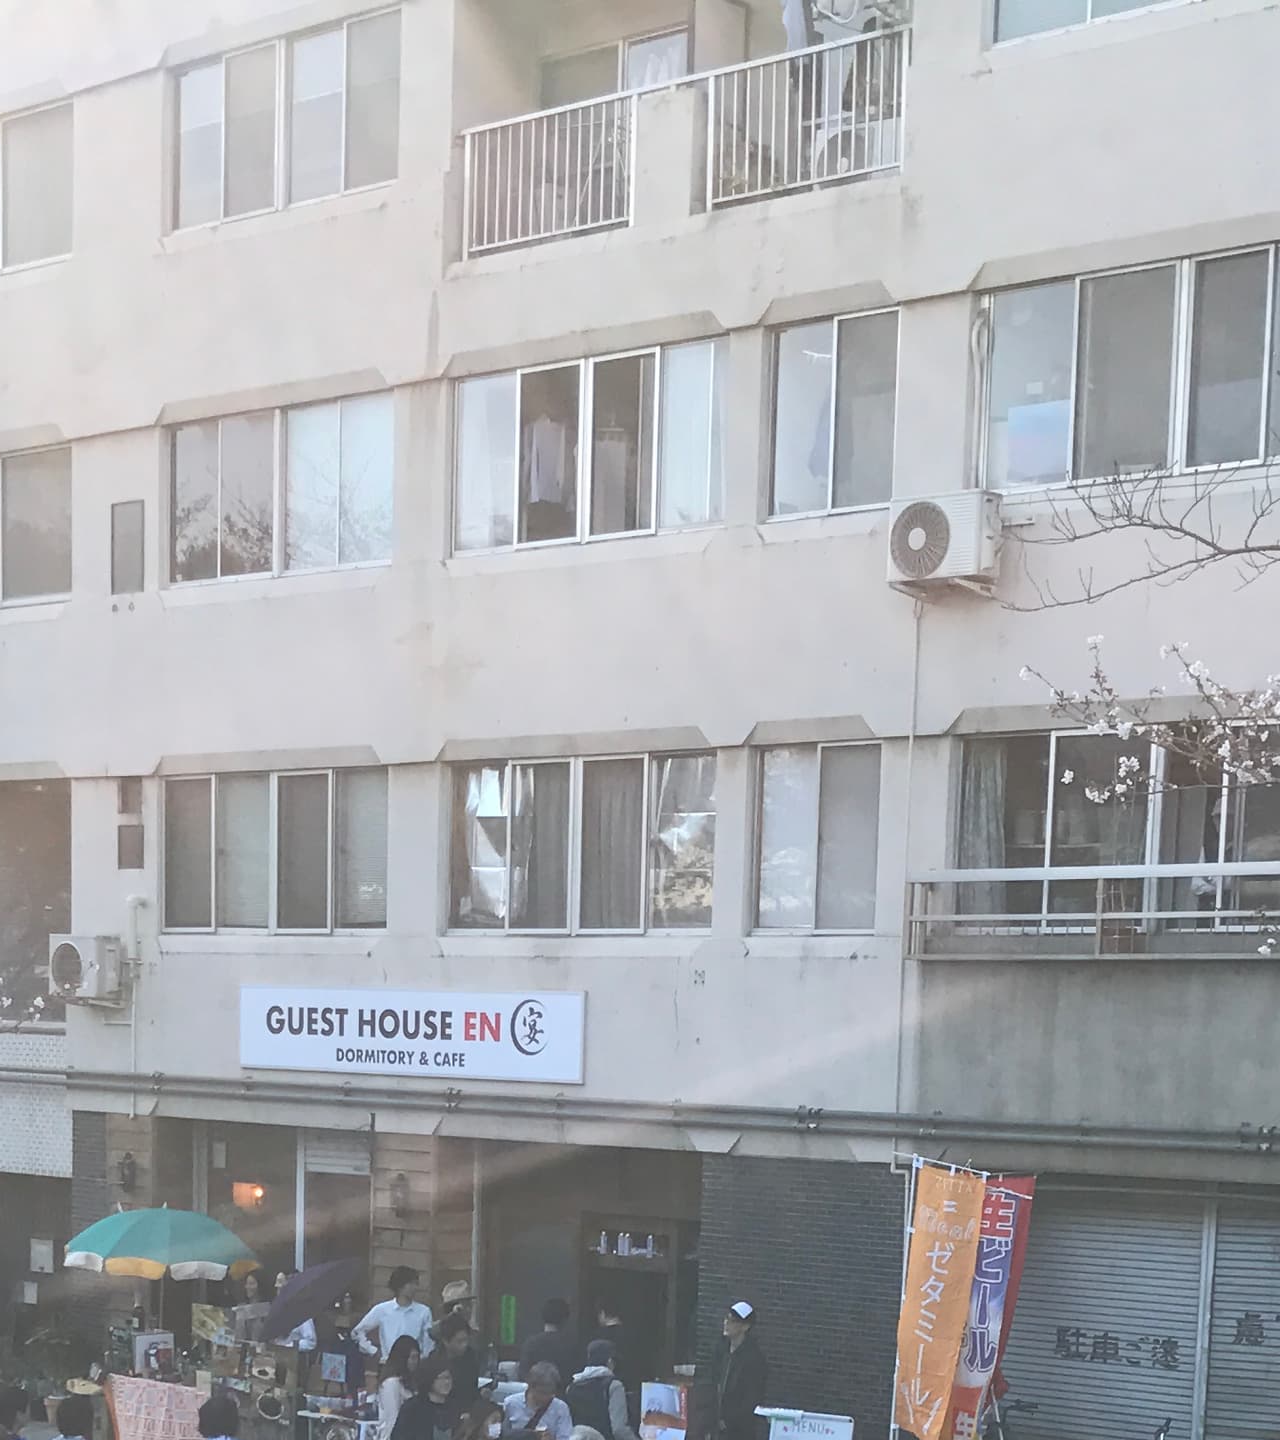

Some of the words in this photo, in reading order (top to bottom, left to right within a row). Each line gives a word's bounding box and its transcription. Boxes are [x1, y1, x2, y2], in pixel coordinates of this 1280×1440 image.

[266, 1005, 349, 1037] GUEST
[358, 1008, 453, 1041] HOUSE
[463, 1011, 501, 1042] EN
[336, 1047, 415, 1065] DORMITORY
[419, 1051, 429, 1066] &
[433, 1051, 466, 1067] CAFE
[964, 1190, 1016, 1373] 生ビール
